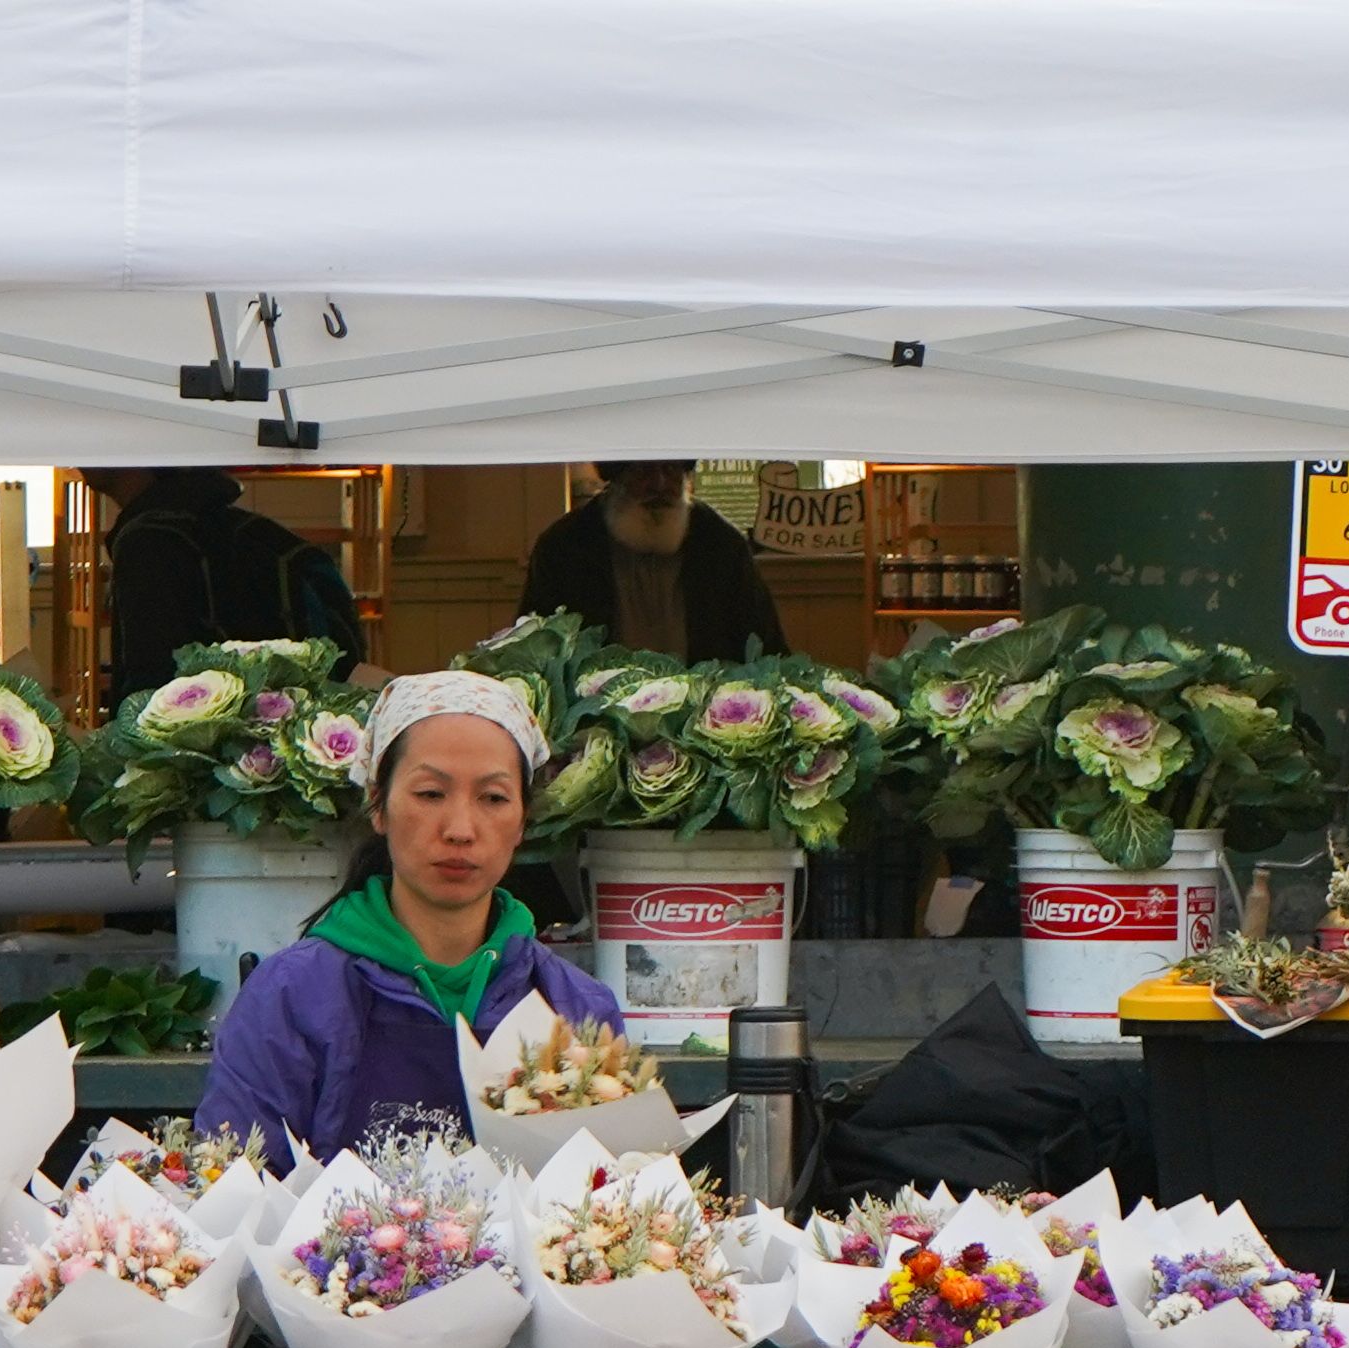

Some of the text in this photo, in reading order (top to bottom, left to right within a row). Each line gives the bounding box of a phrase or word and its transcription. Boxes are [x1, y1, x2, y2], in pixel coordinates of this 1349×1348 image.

[764, 528, 865, 548] FOR SALE
[1314, 626, 1345, 638] Phone
[638, 899, 742, 924] WESTC
[1031, 899, 1116, 923] WESTCO
